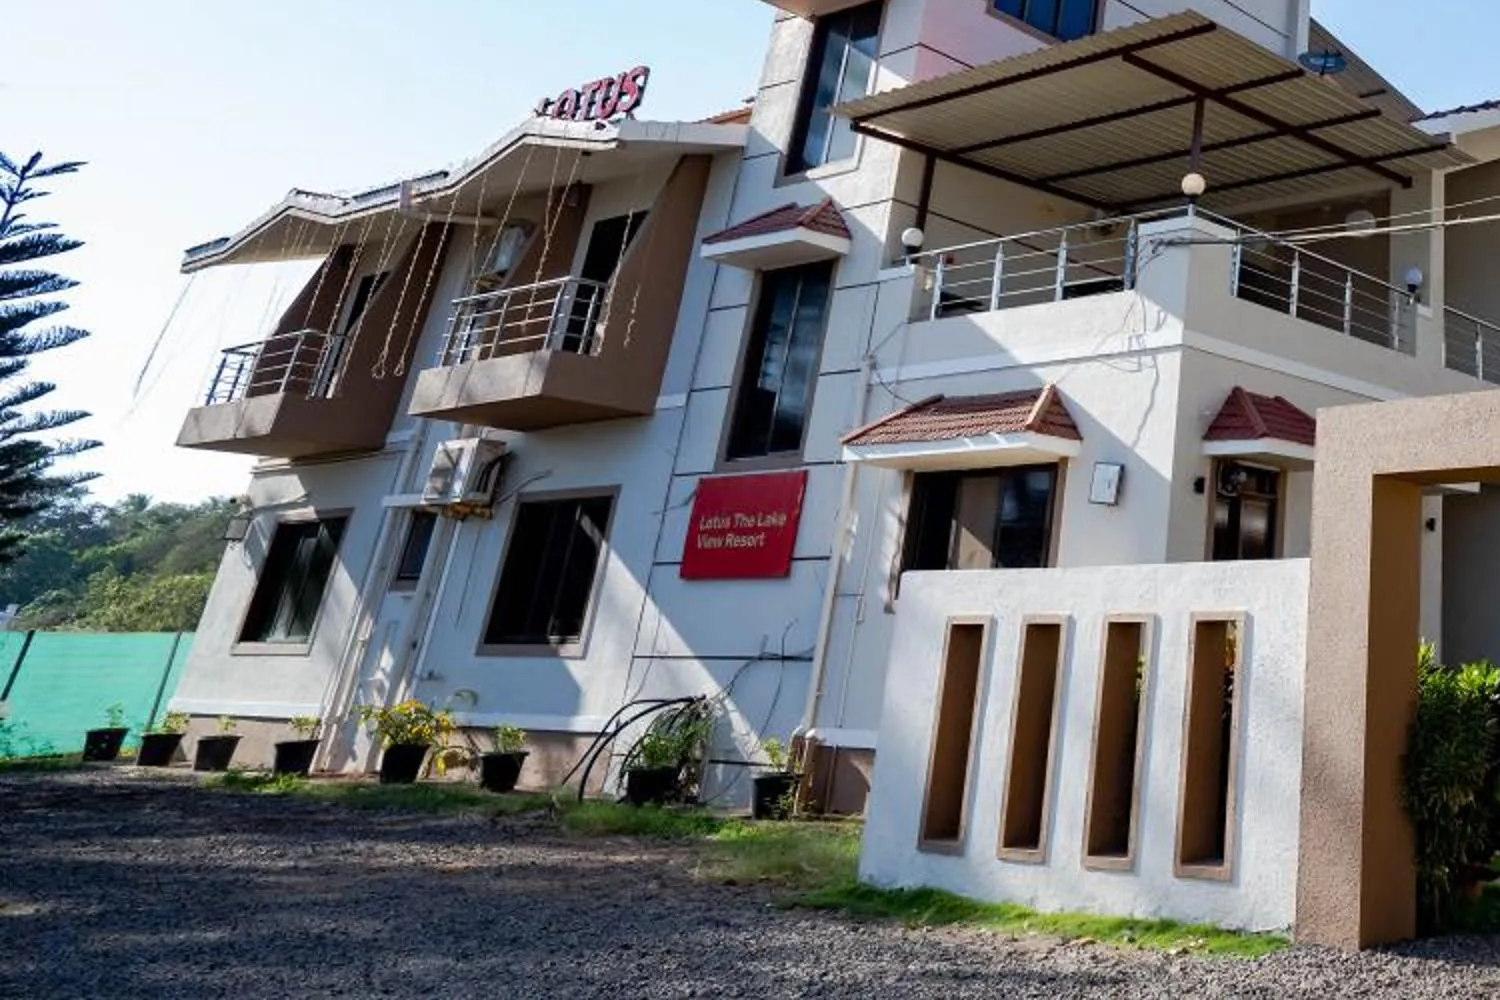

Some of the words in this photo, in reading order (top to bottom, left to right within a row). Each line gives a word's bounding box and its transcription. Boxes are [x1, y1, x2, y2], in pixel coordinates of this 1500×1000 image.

[733, 512, 755, 528] The
[757, 511, 787, 527] Lake
[697, 533, 723, 549] View
[725, 532, 765, 548] Resort
